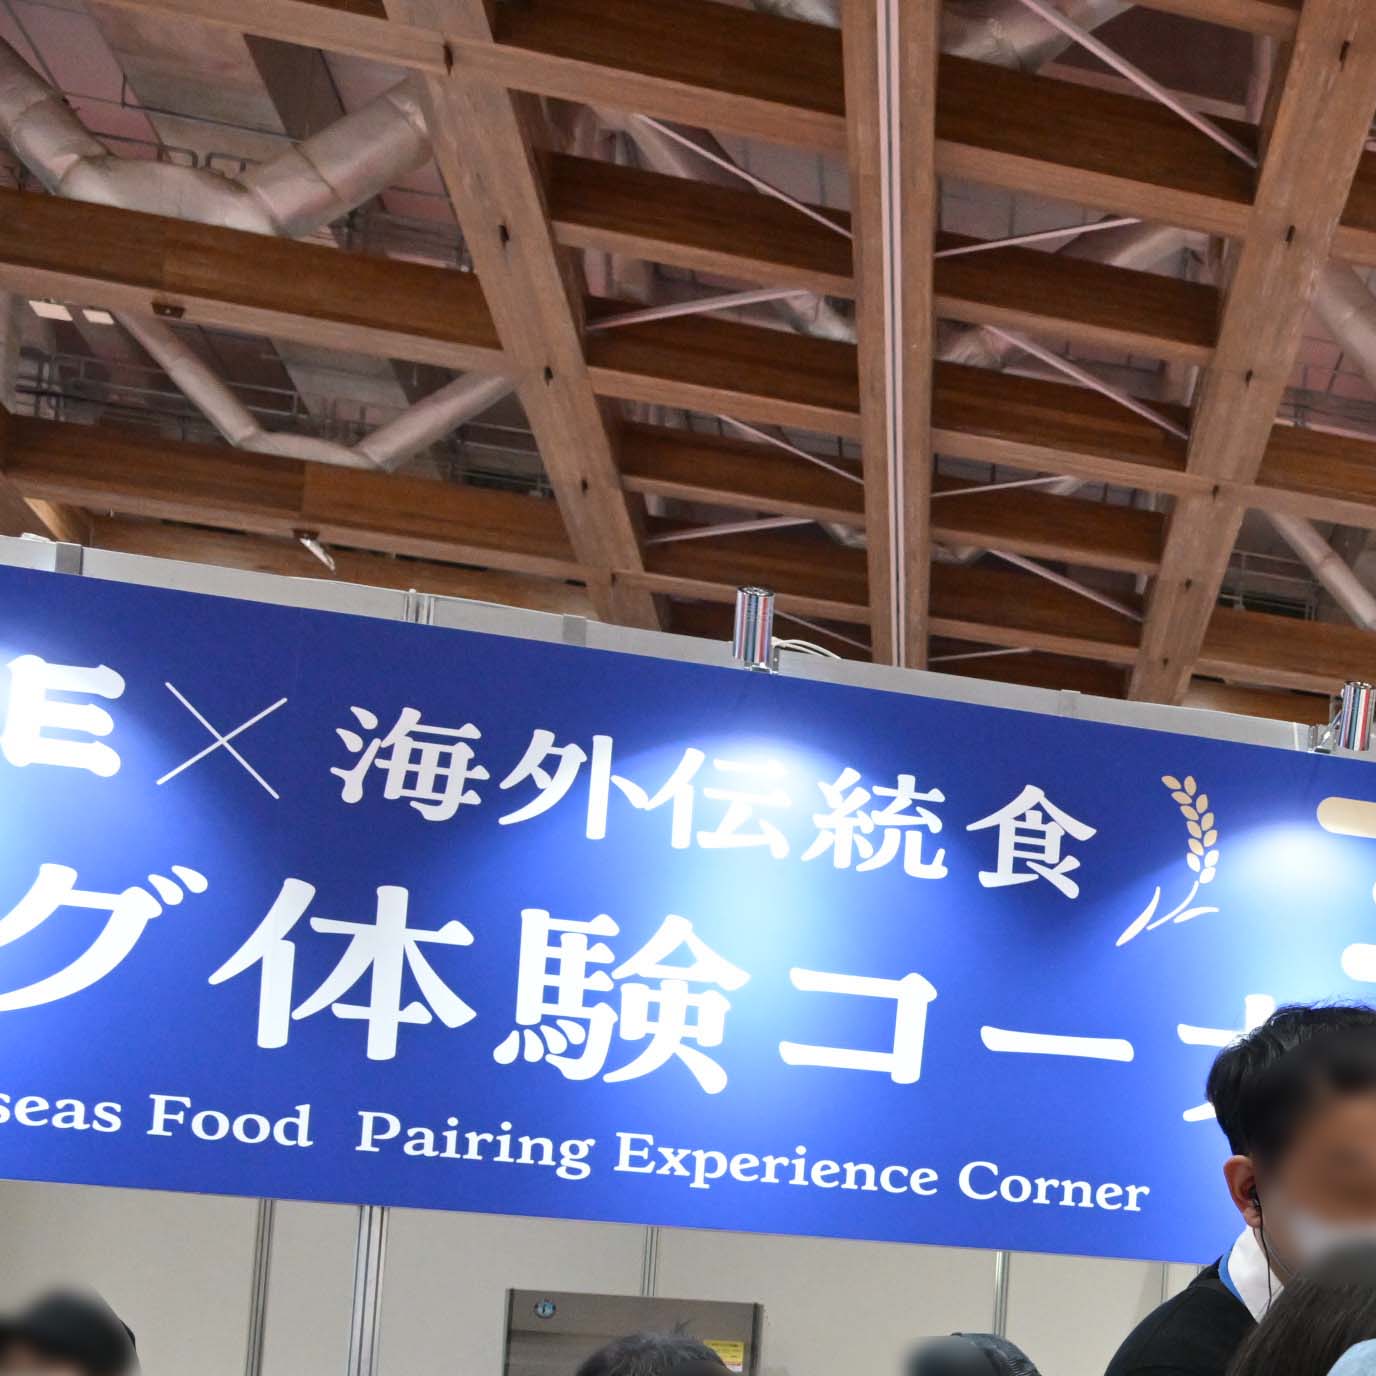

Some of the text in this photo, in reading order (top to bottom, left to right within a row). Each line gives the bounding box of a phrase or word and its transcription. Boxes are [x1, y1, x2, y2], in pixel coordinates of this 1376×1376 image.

[147, 1093, 313, 1147] Food
[356, 1110, 596, 1179] Pairing
[615, 1132, 938, 1197] Experience
[958, 1161, 1149, 1213] Corner
